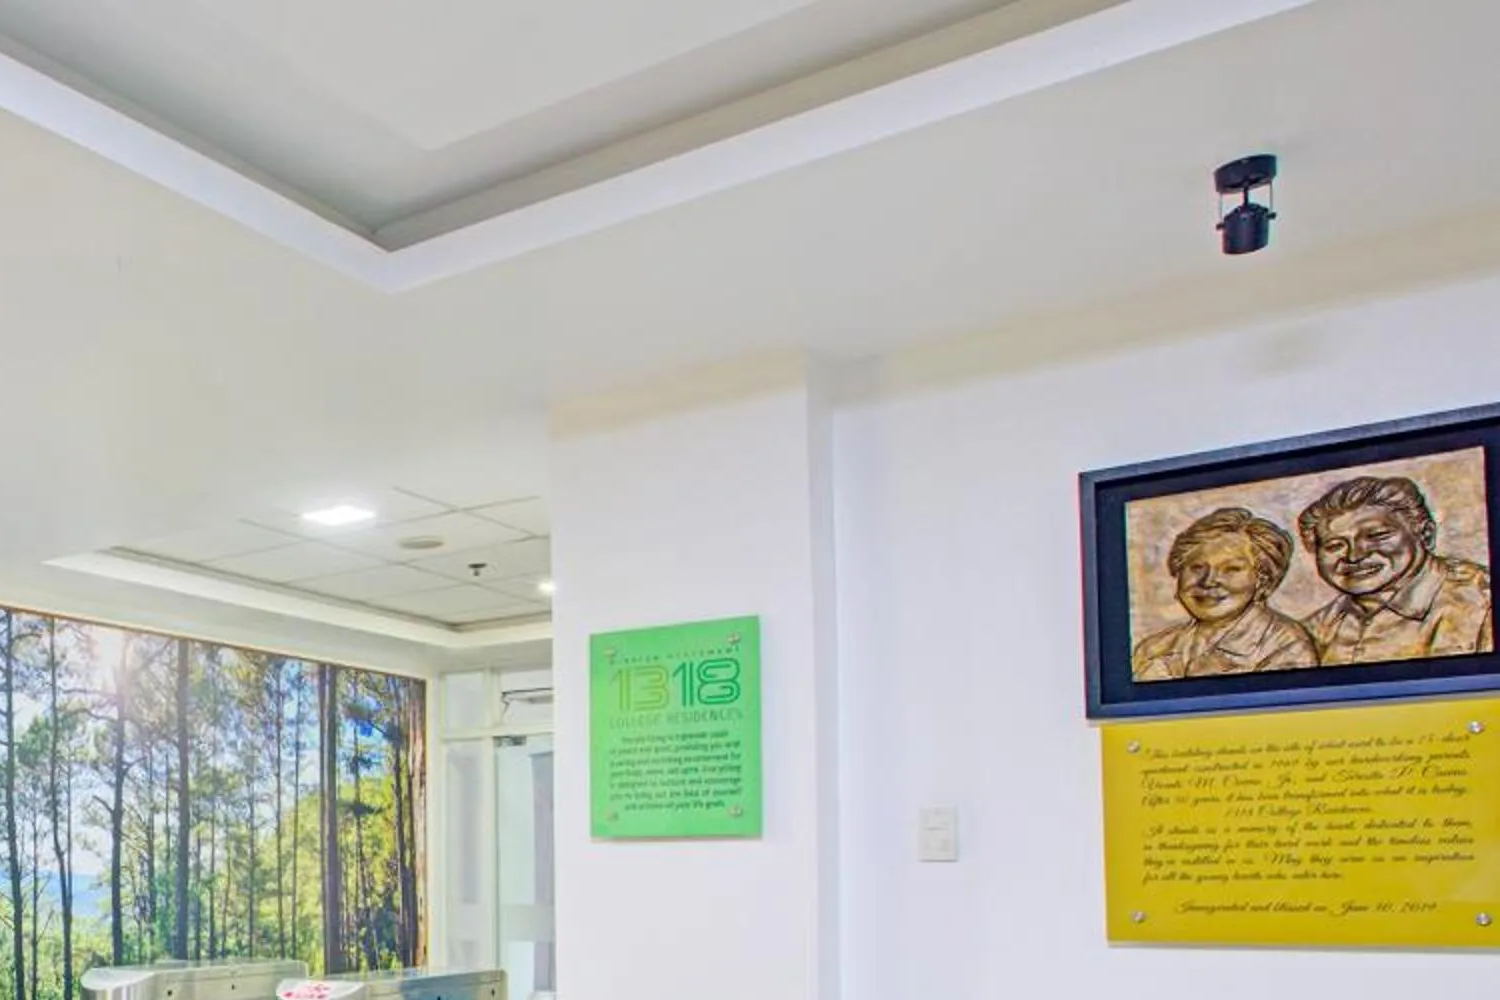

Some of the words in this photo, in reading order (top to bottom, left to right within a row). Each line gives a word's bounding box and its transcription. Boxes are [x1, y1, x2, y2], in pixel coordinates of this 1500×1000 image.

[609, 657, 741, 711] 1318
[610, 712, 662, 729] COLLEGE
[666, 708, 744, 725] RESIDENCES
